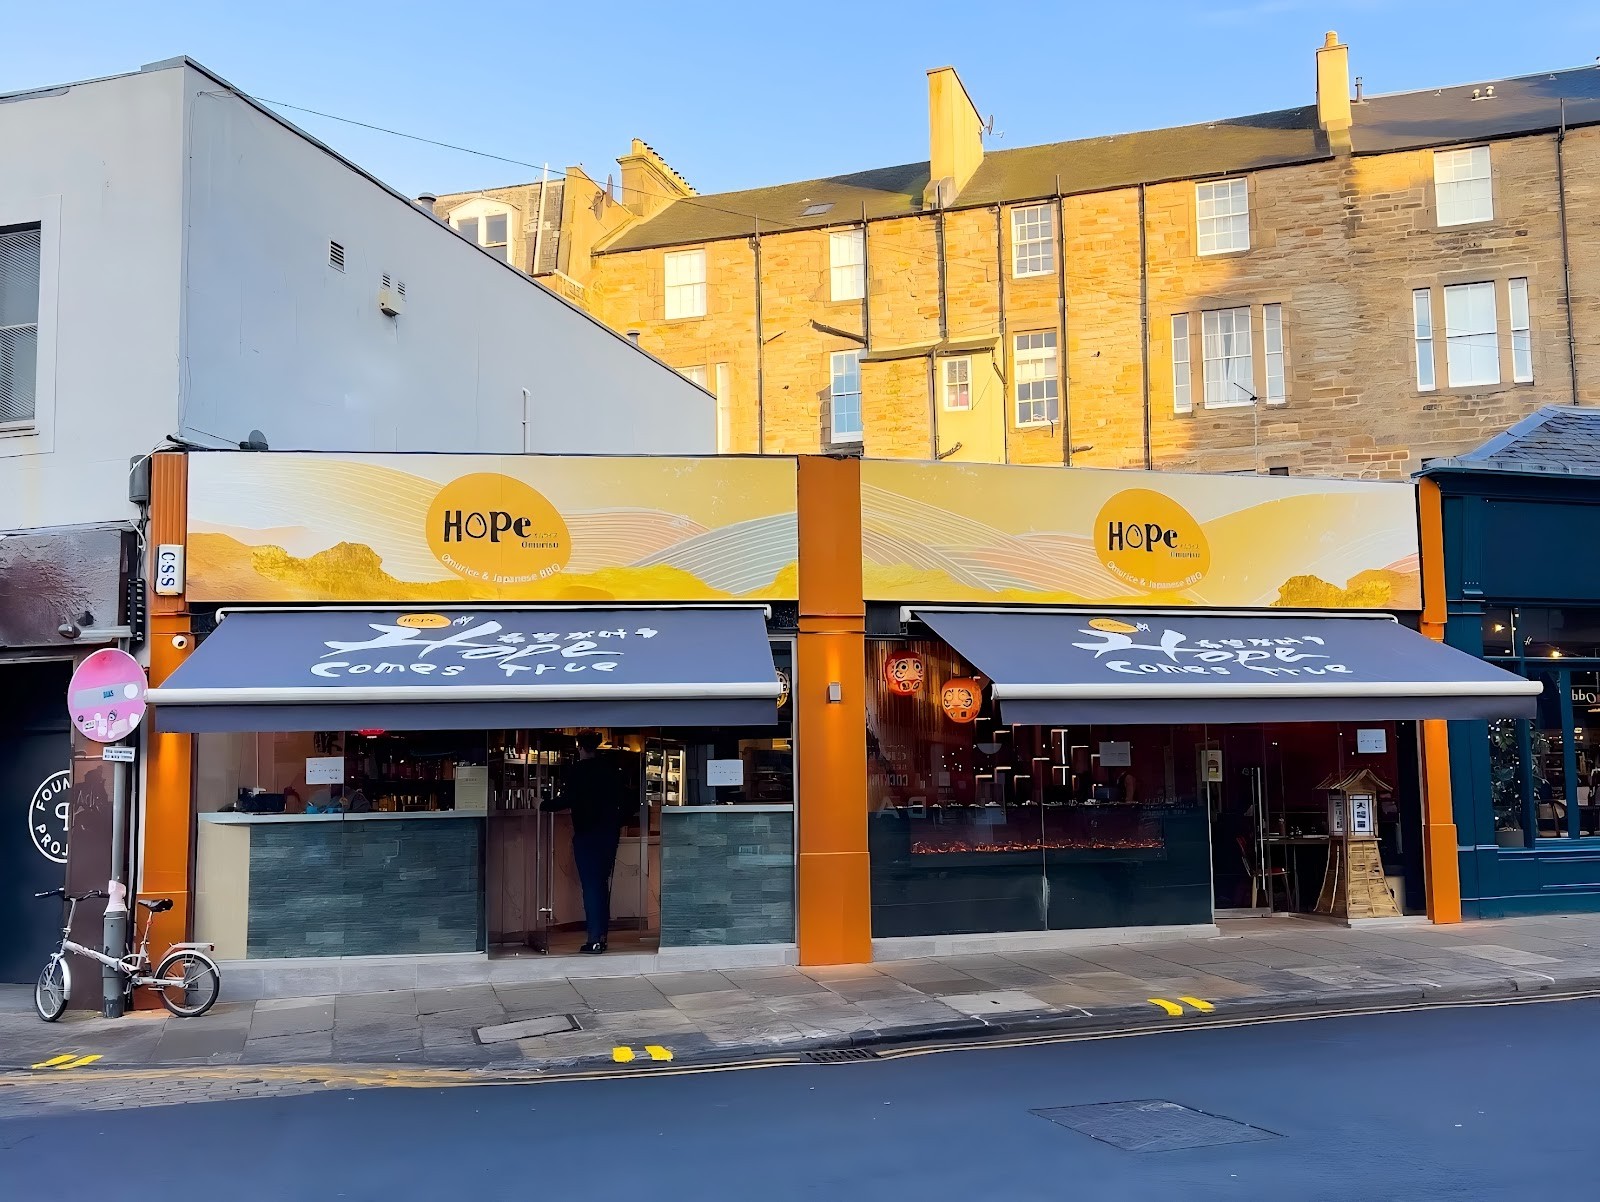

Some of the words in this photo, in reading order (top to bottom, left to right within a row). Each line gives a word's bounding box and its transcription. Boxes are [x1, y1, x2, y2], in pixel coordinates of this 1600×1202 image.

[441, 553, 479, 577] Omurice
[481, 571, 489, 580] &
[492, 573, 538, 583] Japanese
[539, 563, 561, 578] BBQ
[1139, 578, 1146, 586] &
